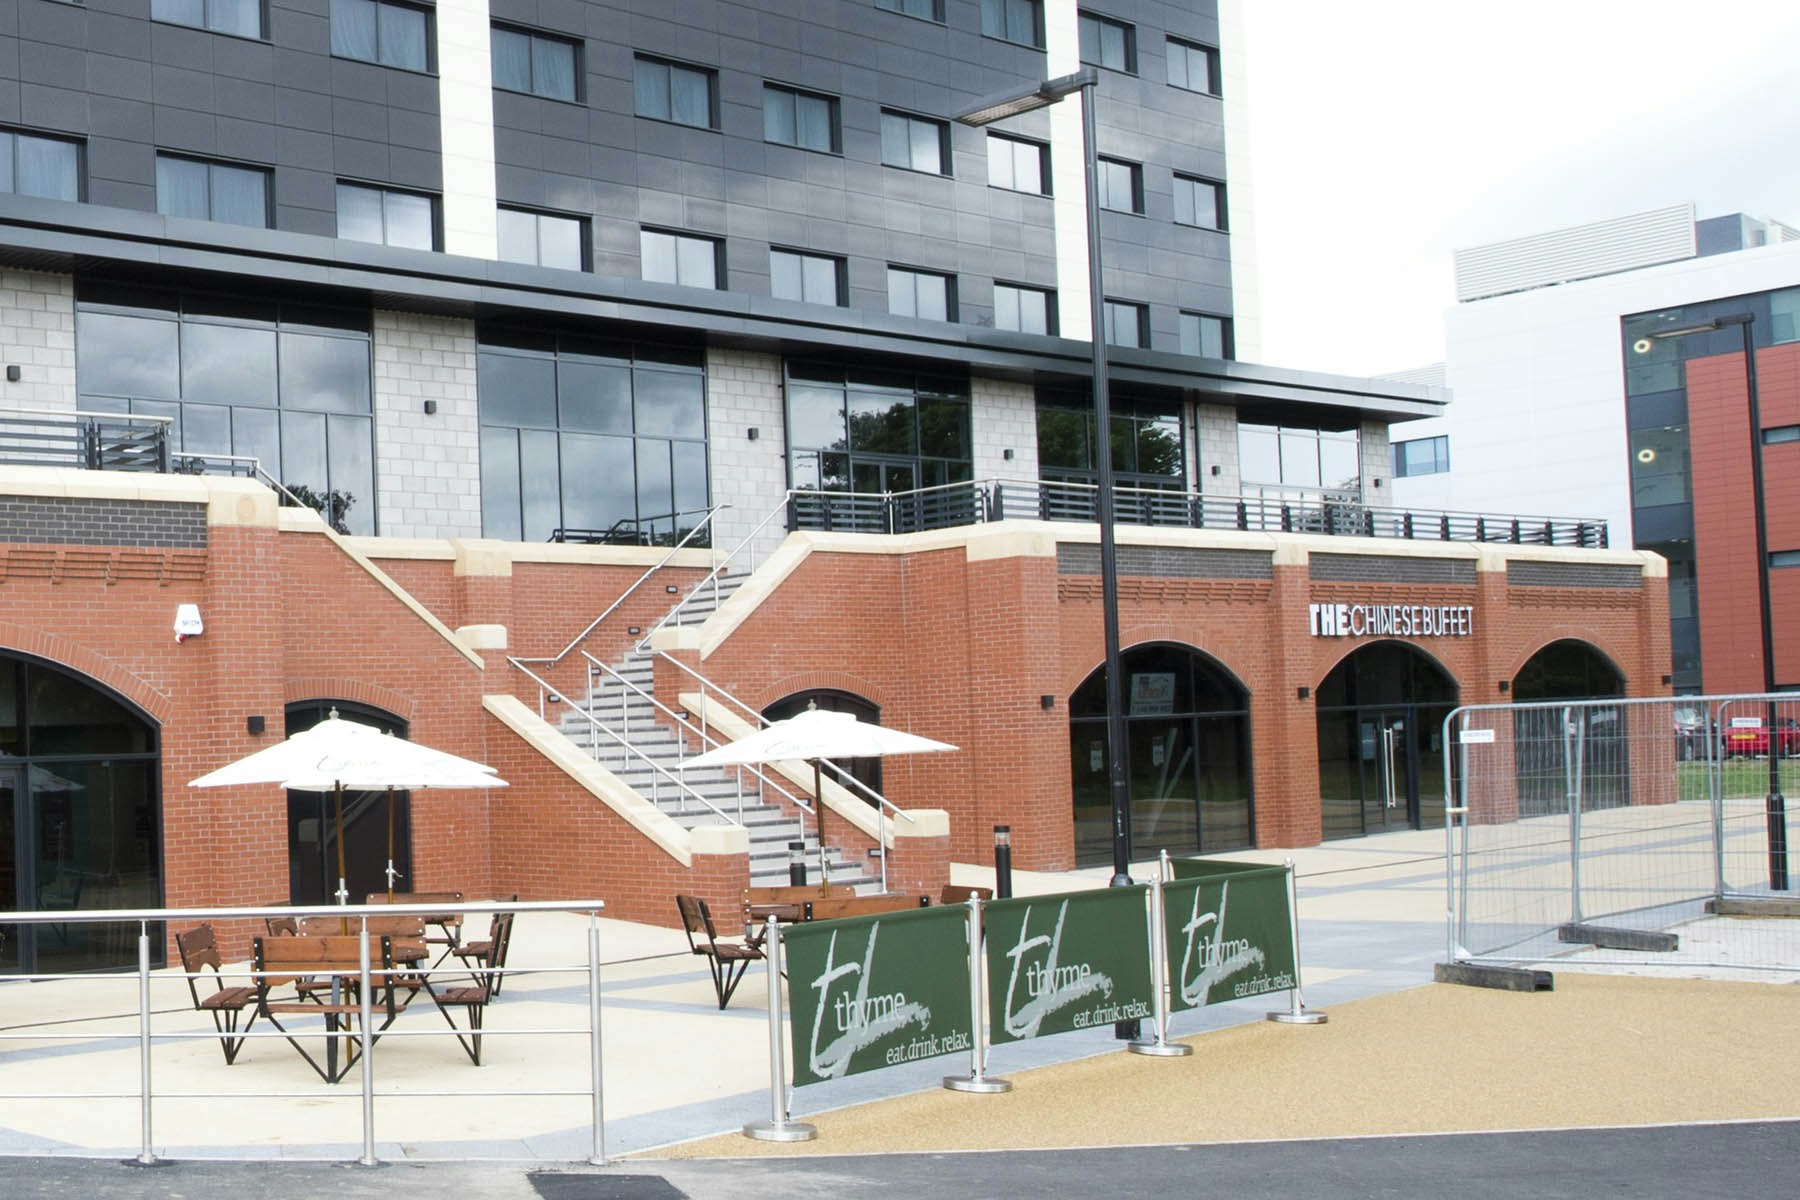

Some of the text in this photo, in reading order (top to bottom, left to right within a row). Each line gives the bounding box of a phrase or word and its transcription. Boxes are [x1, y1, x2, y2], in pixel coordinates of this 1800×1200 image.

[1309, 603, 1473, 636] THE CHINESE BUFFET
[1198, 936, 1249, 972] thyme
[1026, 960, 1091, 1001] thyme
[834, 991, 906, 1037] thyme
